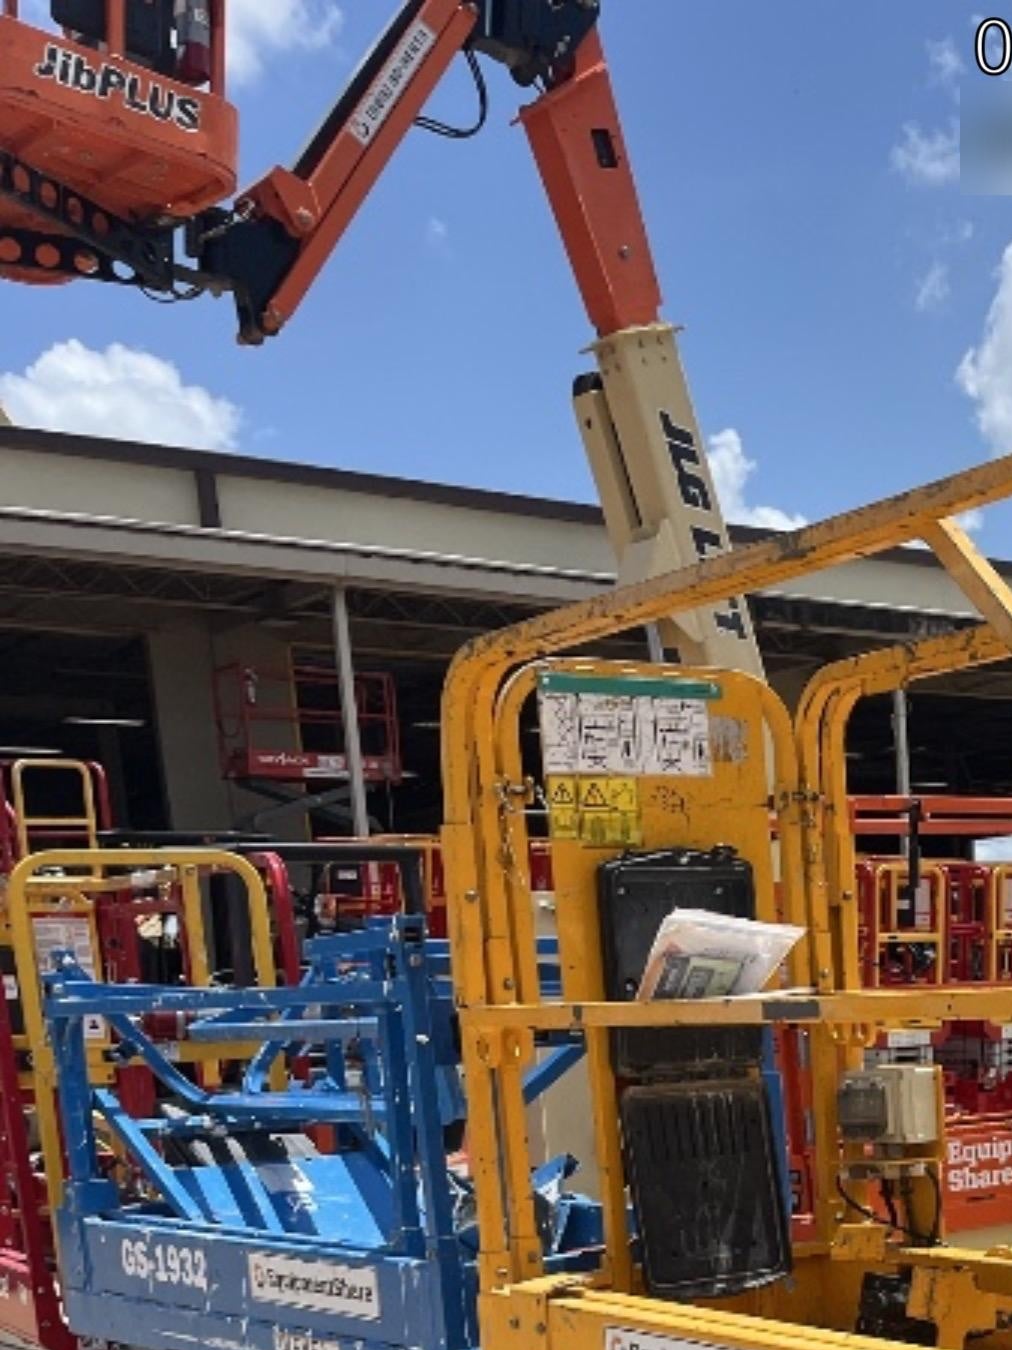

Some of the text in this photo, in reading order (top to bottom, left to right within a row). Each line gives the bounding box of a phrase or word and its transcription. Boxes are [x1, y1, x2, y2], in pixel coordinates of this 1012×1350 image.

[34, 42, 201, 133] JibPLUS
[659, 410, 712, 511] JLG
[121, 1239, 208, 1291] GS-1932
